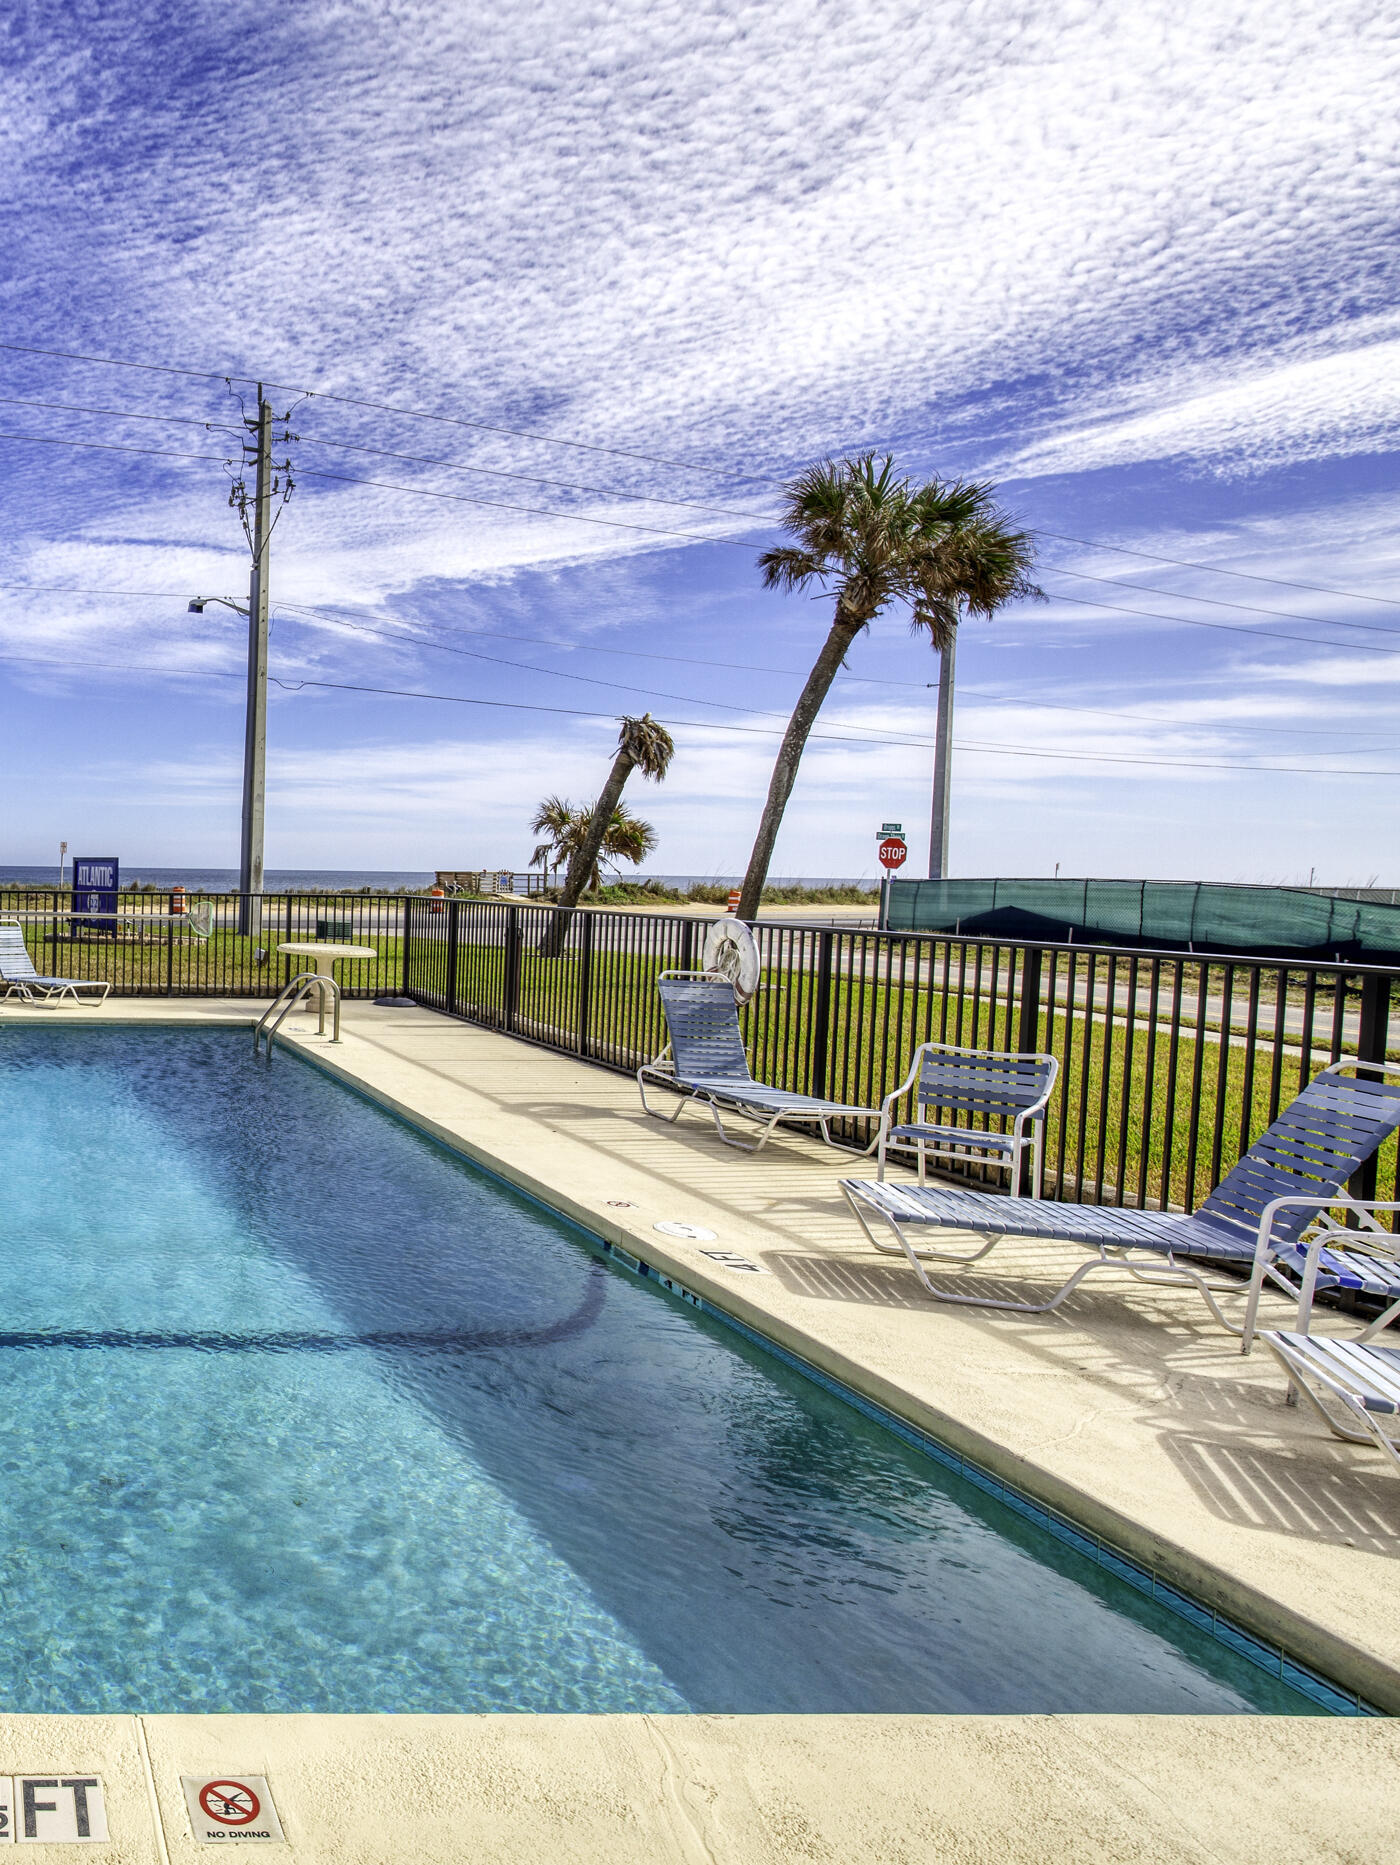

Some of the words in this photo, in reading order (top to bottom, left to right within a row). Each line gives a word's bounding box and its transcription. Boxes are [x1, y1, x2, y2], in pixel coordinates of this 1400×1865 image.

[880, 847, 905, 860] STOP
[78, 866, 114, 888] ATLANTIC
[698, 1249, 745, 1261] FT
[21, 1778, 98, 1838] FT
[206, 1831, 225, 1839] NO
[228, 1831, 271, 1839] DIVING
